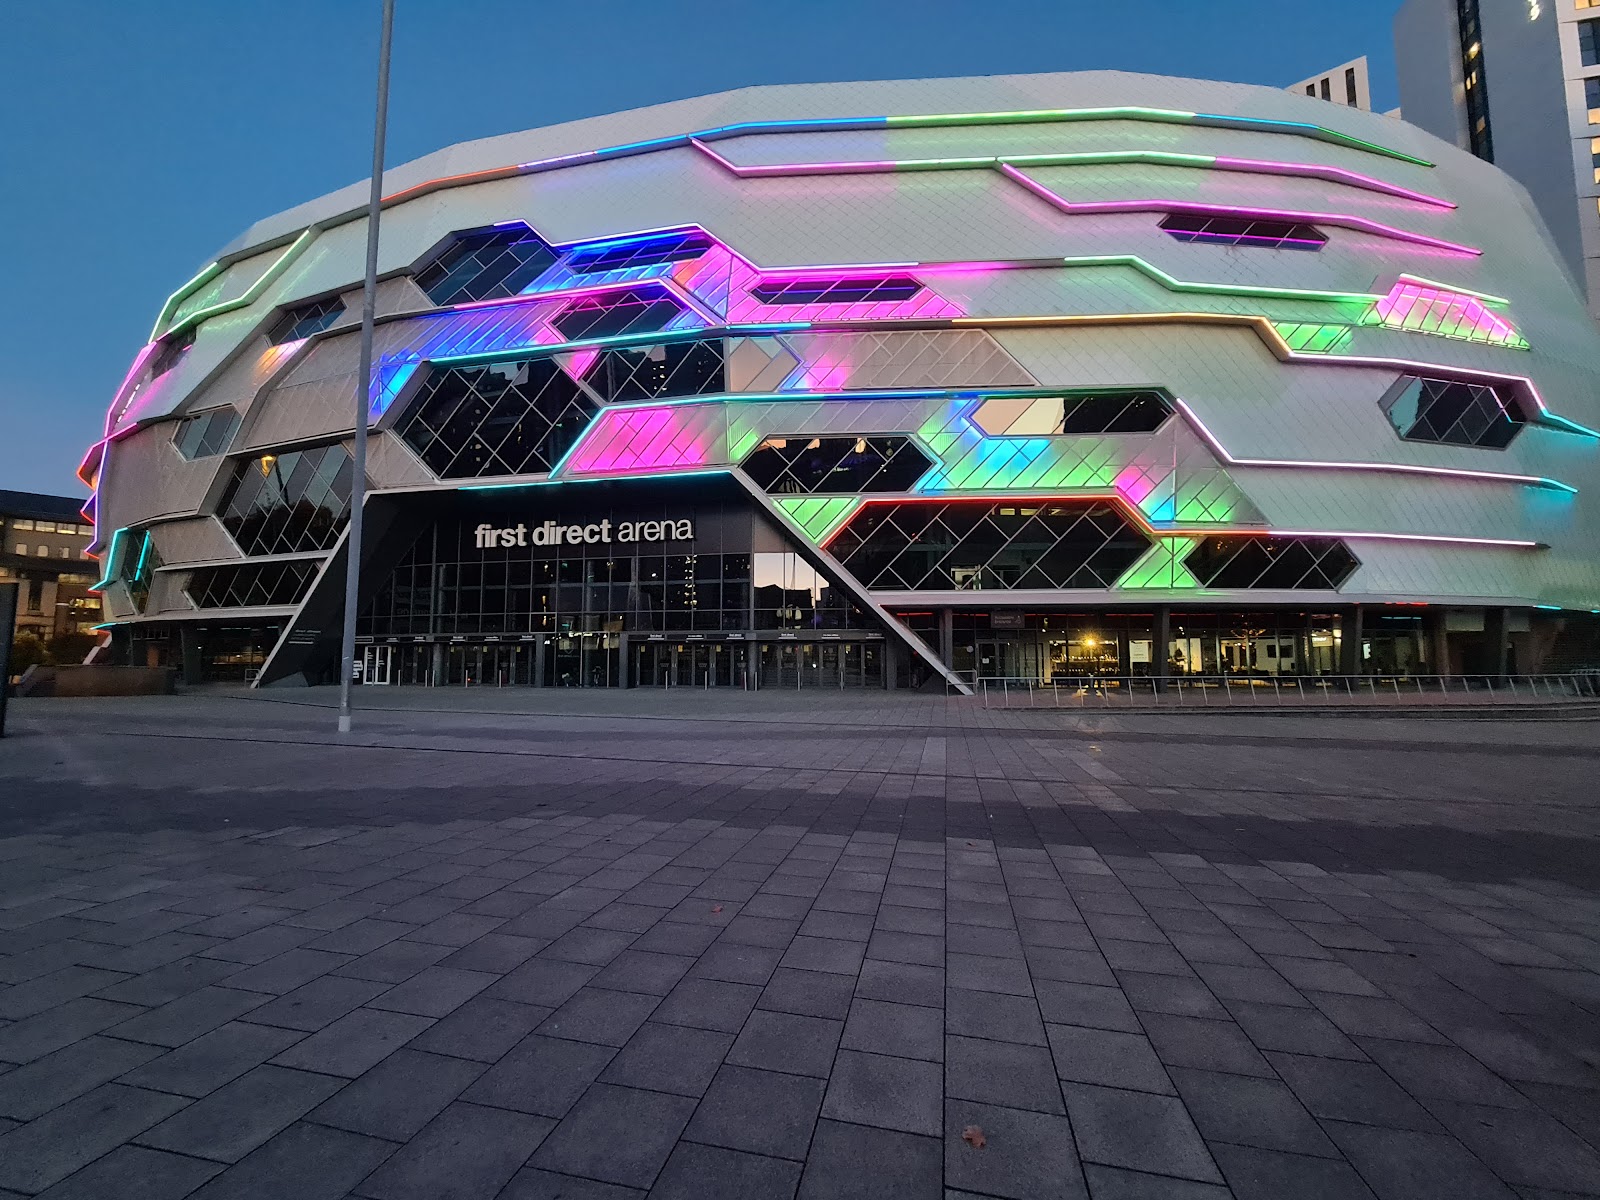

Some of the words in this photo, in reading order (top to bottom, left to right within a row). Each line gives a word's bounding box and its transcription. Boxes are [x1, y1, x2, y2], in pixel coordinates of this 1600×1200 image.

[475, 523, 527, 548] first
[532, 519, 611, 545] direct
[618, 519, 693, 542] arena
